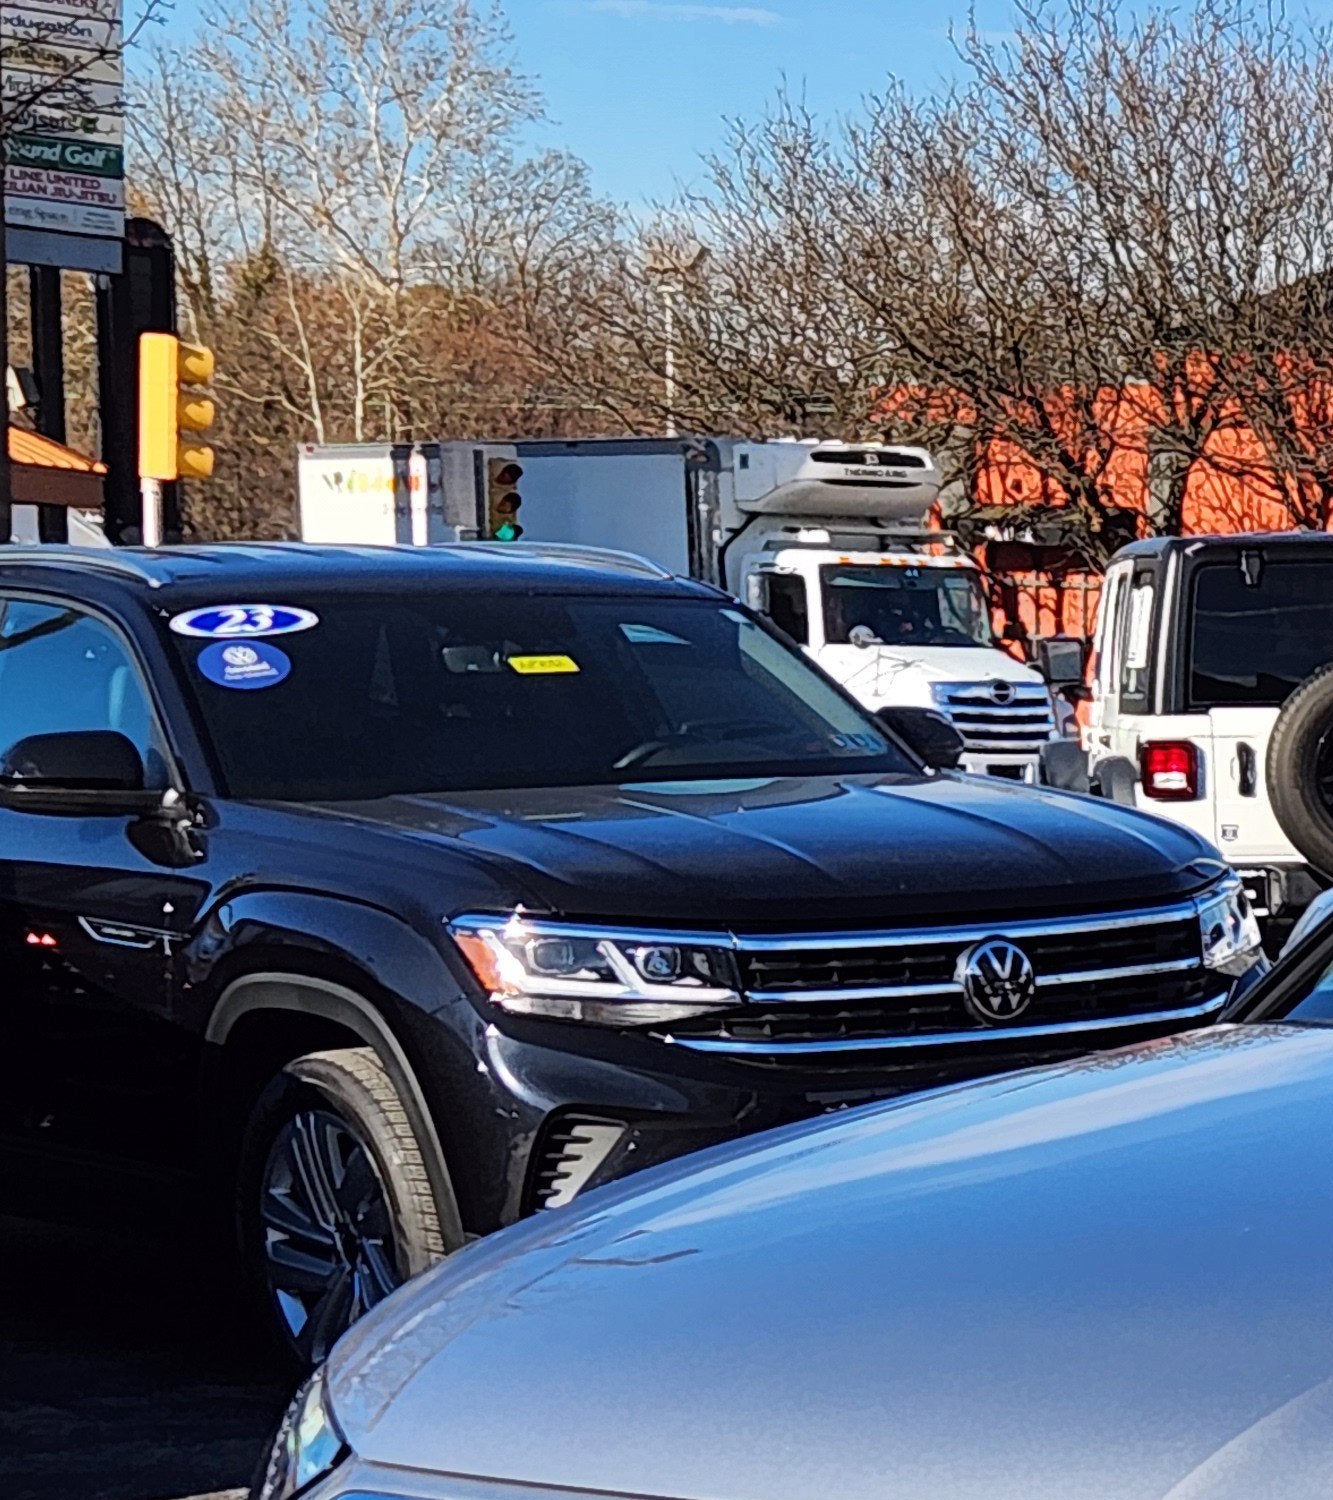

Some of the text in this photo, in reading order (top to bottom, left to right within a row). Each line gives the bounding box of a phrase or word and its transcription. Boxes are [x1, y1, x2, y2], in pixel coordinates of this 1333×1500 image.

[64, 146, 107, 167] Golf
[46, 172, 101, 190] UNITED
[213, 605, 275, 634] 23
